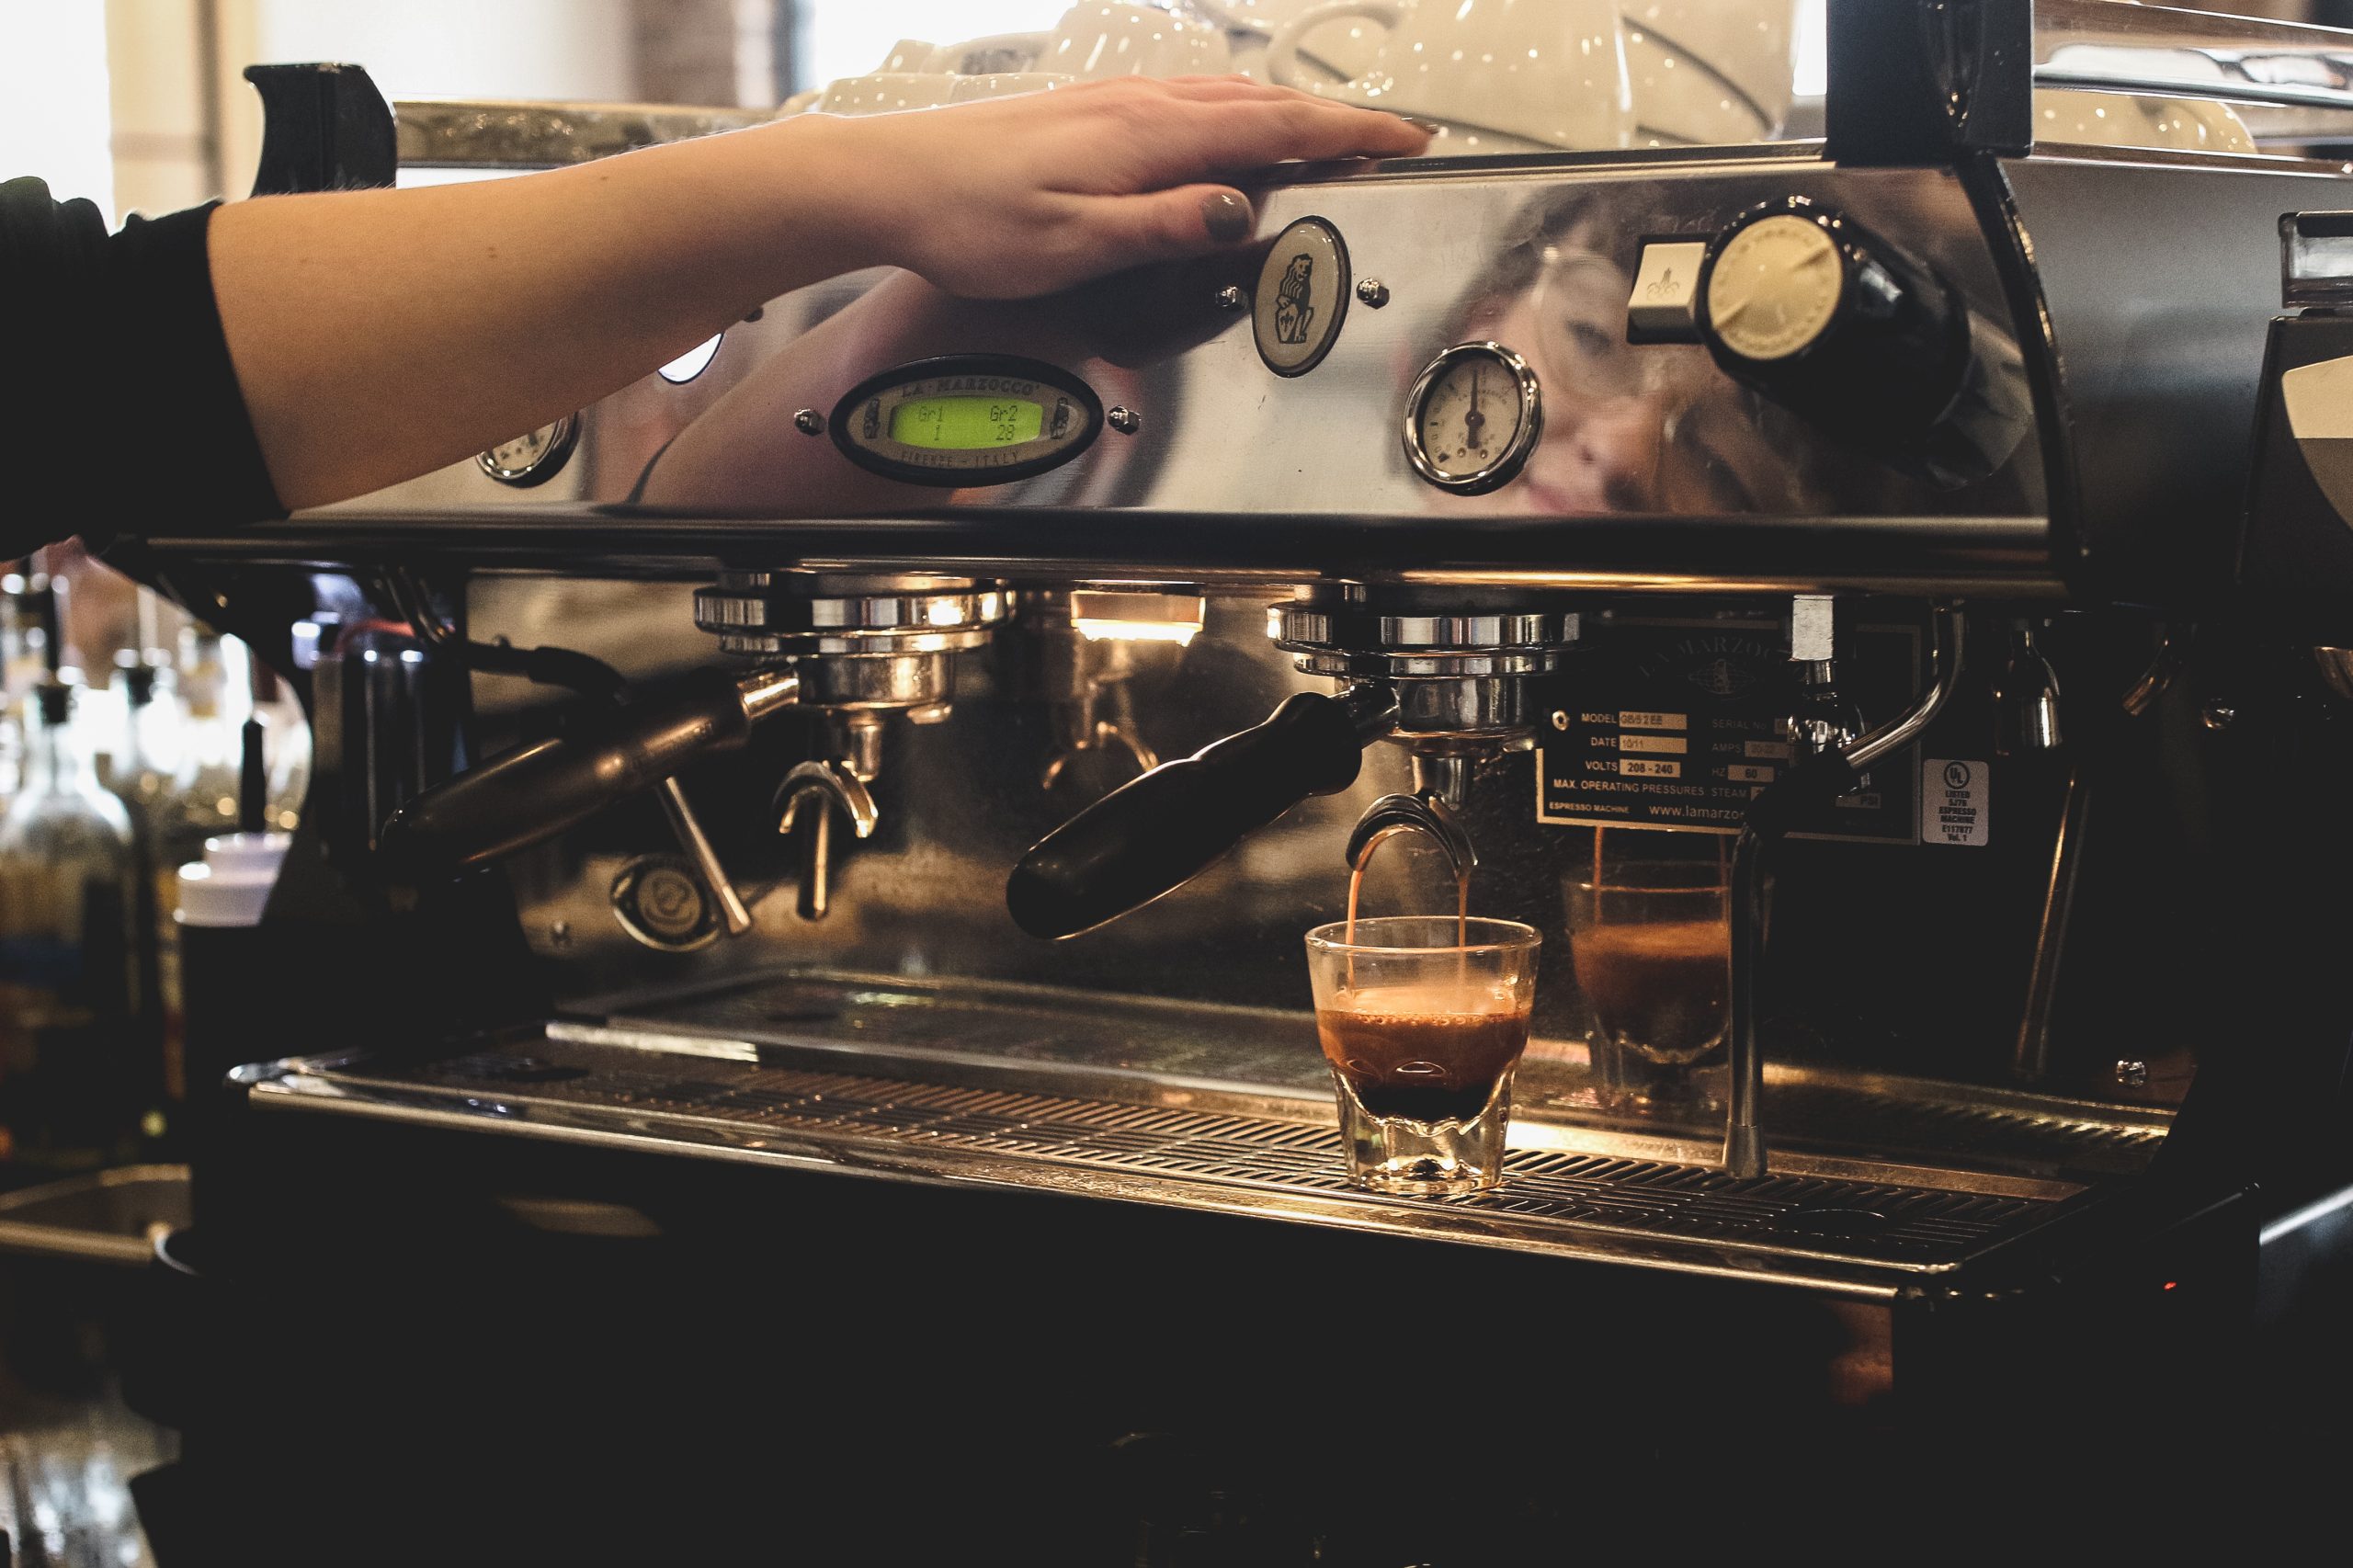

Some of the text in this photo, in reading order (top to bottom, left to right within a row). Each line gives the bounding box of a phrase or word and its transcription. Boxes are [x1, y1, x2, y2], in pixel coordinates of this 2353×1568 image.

[902, 382, 924, 397] LA
[918, 405, 1017, 423] Gr1 Gr2
[934, 425, 939, 441] 1
[974, 451, 1018, 467] ITALY
[1581, 712, 1618, 724] MODEL
[1711, 718, 1749, 729] SERIAL
[1590, 736, 1618, 747] DATE
[1711, 742, 1743, 755] AMPS
[1586, 760, 1619, 771] VOLTS
[1628, 762, 1645, 773] 208
[1654, 764, 1673, 775] 240
[1711, 767, 1726, 778] HZ
[1581, 780, 1640, 793] OPERATING
[1642, 783, 1705, 797] PRESSURES
[1711, 787, 1747, 800] STEAM
[1945, 790, 1971, 799] LISTED
[1549, 801, 1631, 814] ESPRESSO MACHINE
[1938, 806, 1977, 816] ESPRESSO
[1940, 814, 1975, 824] MACHINE
